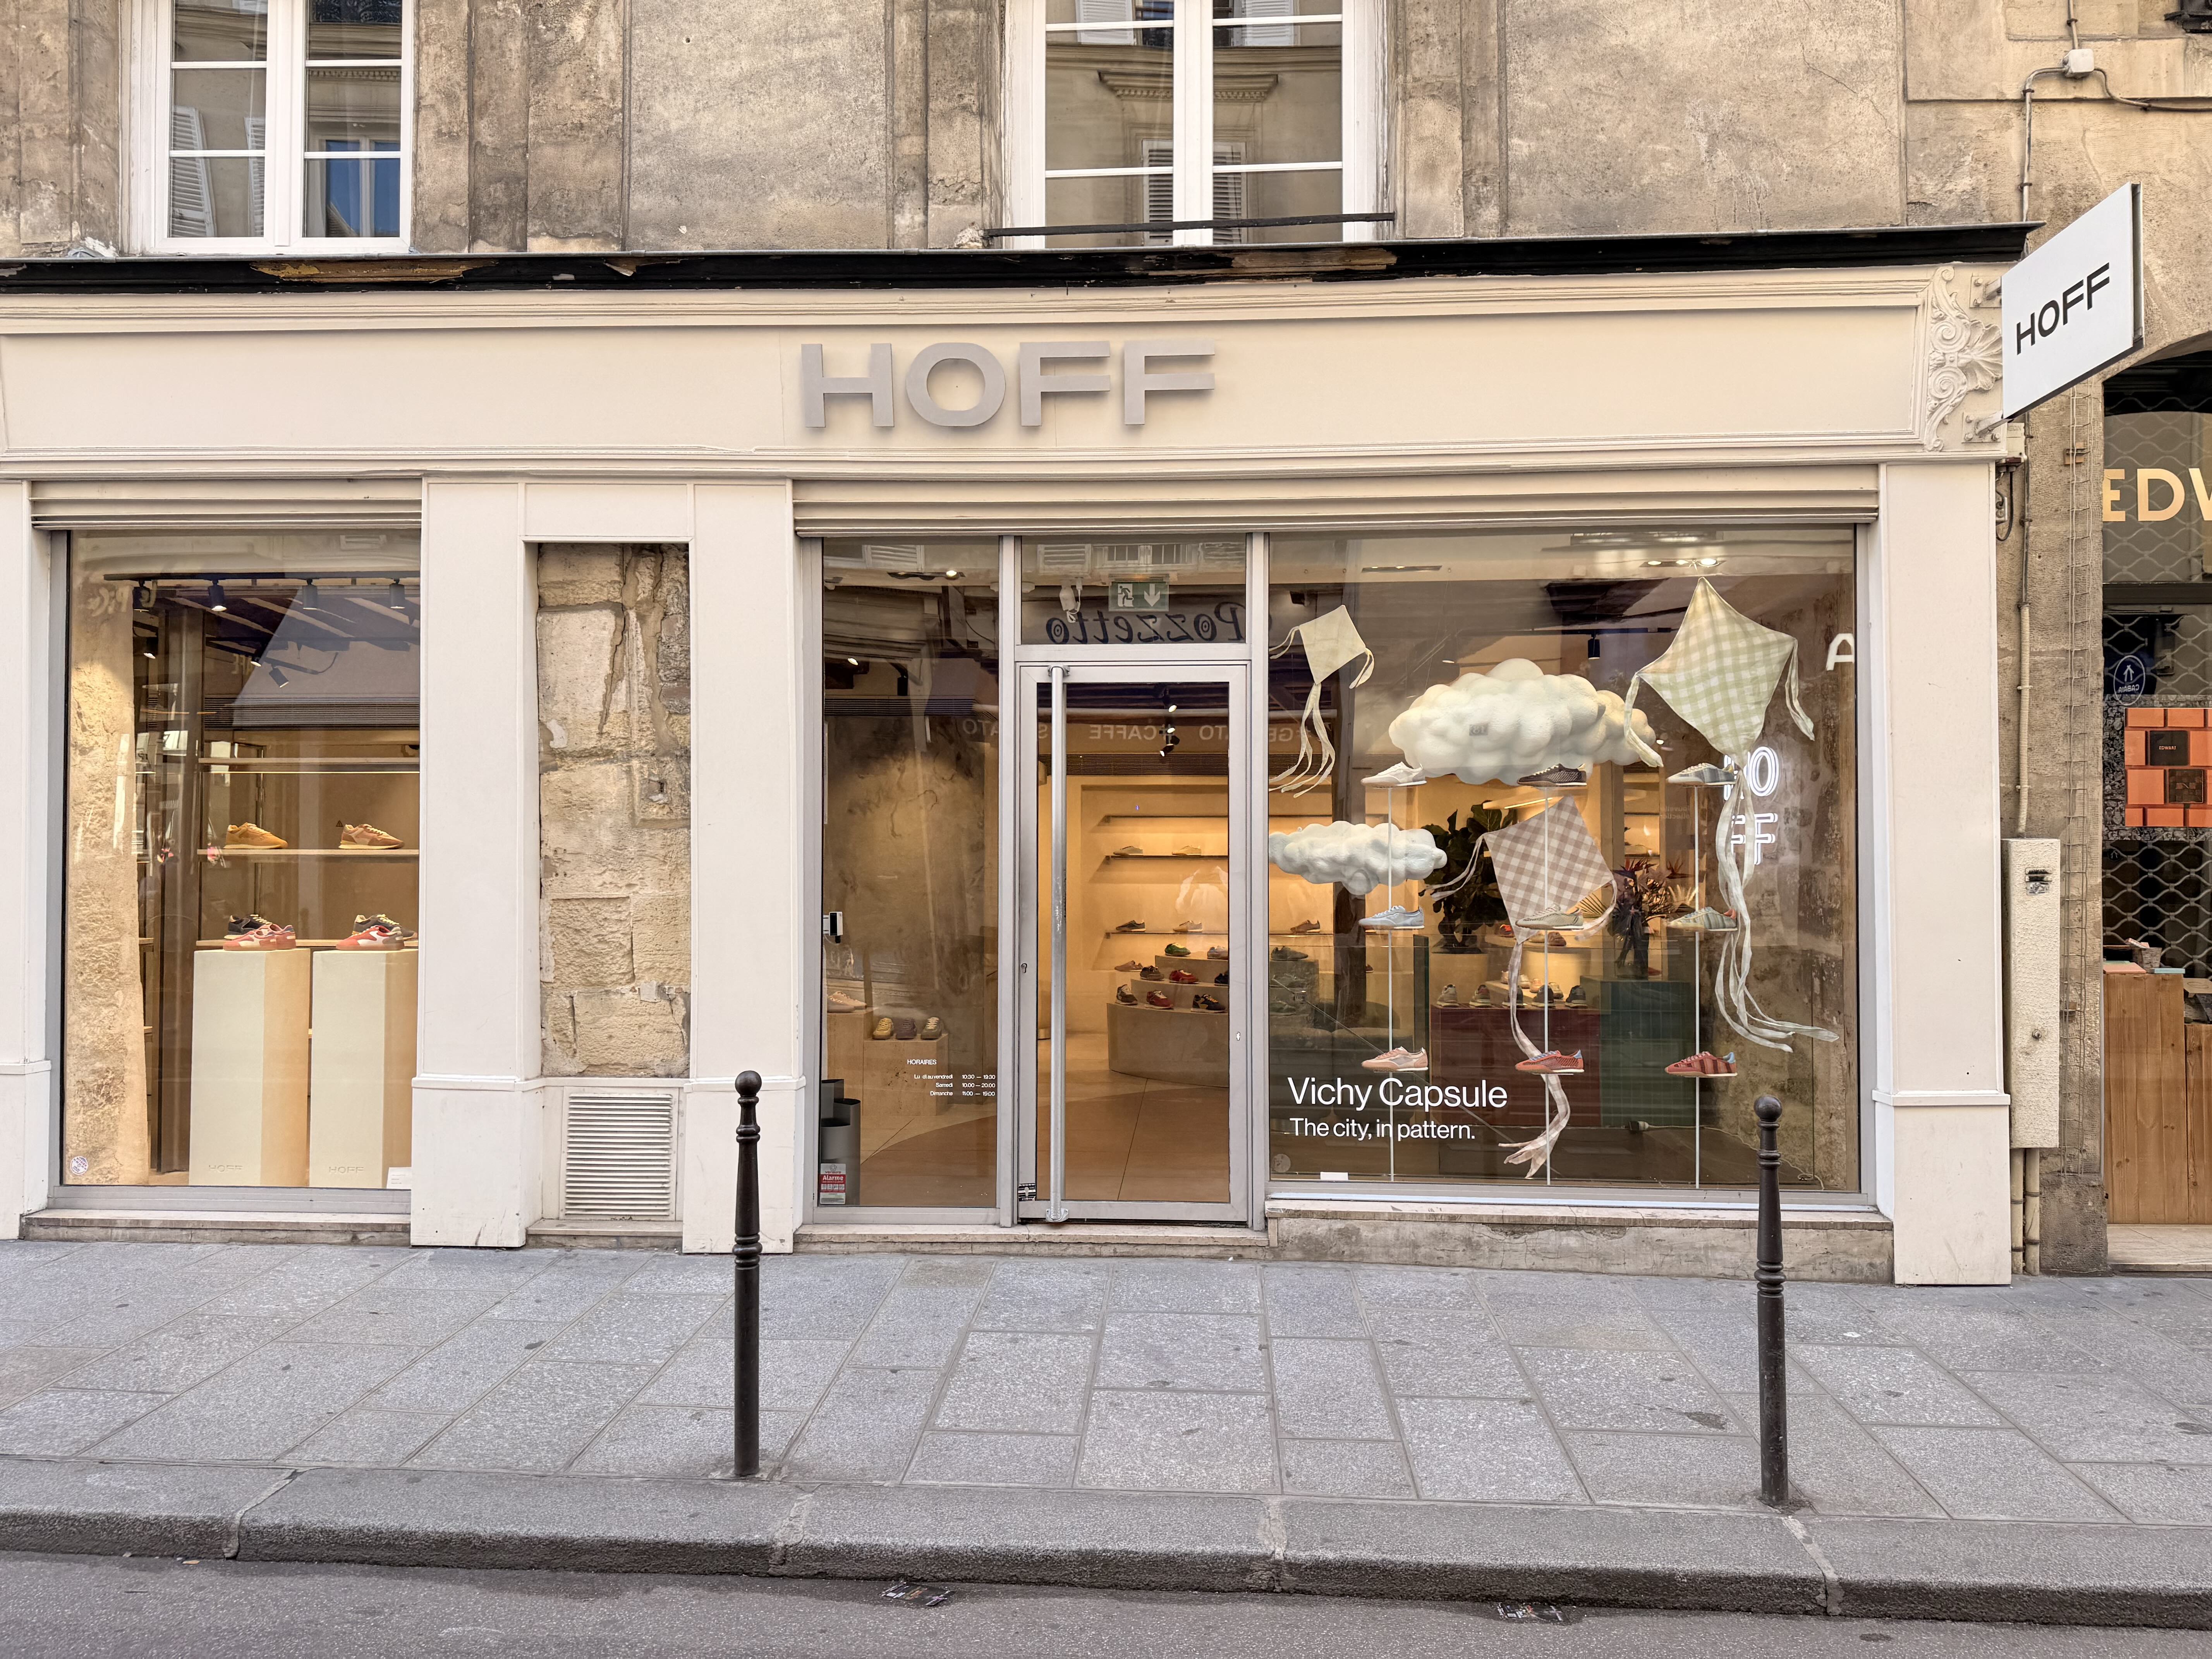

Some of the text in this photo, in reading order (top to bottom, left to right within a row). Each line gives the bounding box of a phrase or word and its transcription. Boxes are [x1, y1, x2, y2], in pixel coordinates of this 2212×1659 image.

[2017, 262, 2109, 355] HOFF
[801, 339, 1215, 427] HOFF
[1288, 1077, 1507, 1112] Vichy Capsule
[1290, 1118, 1475, 1141] The city, in pattern.
